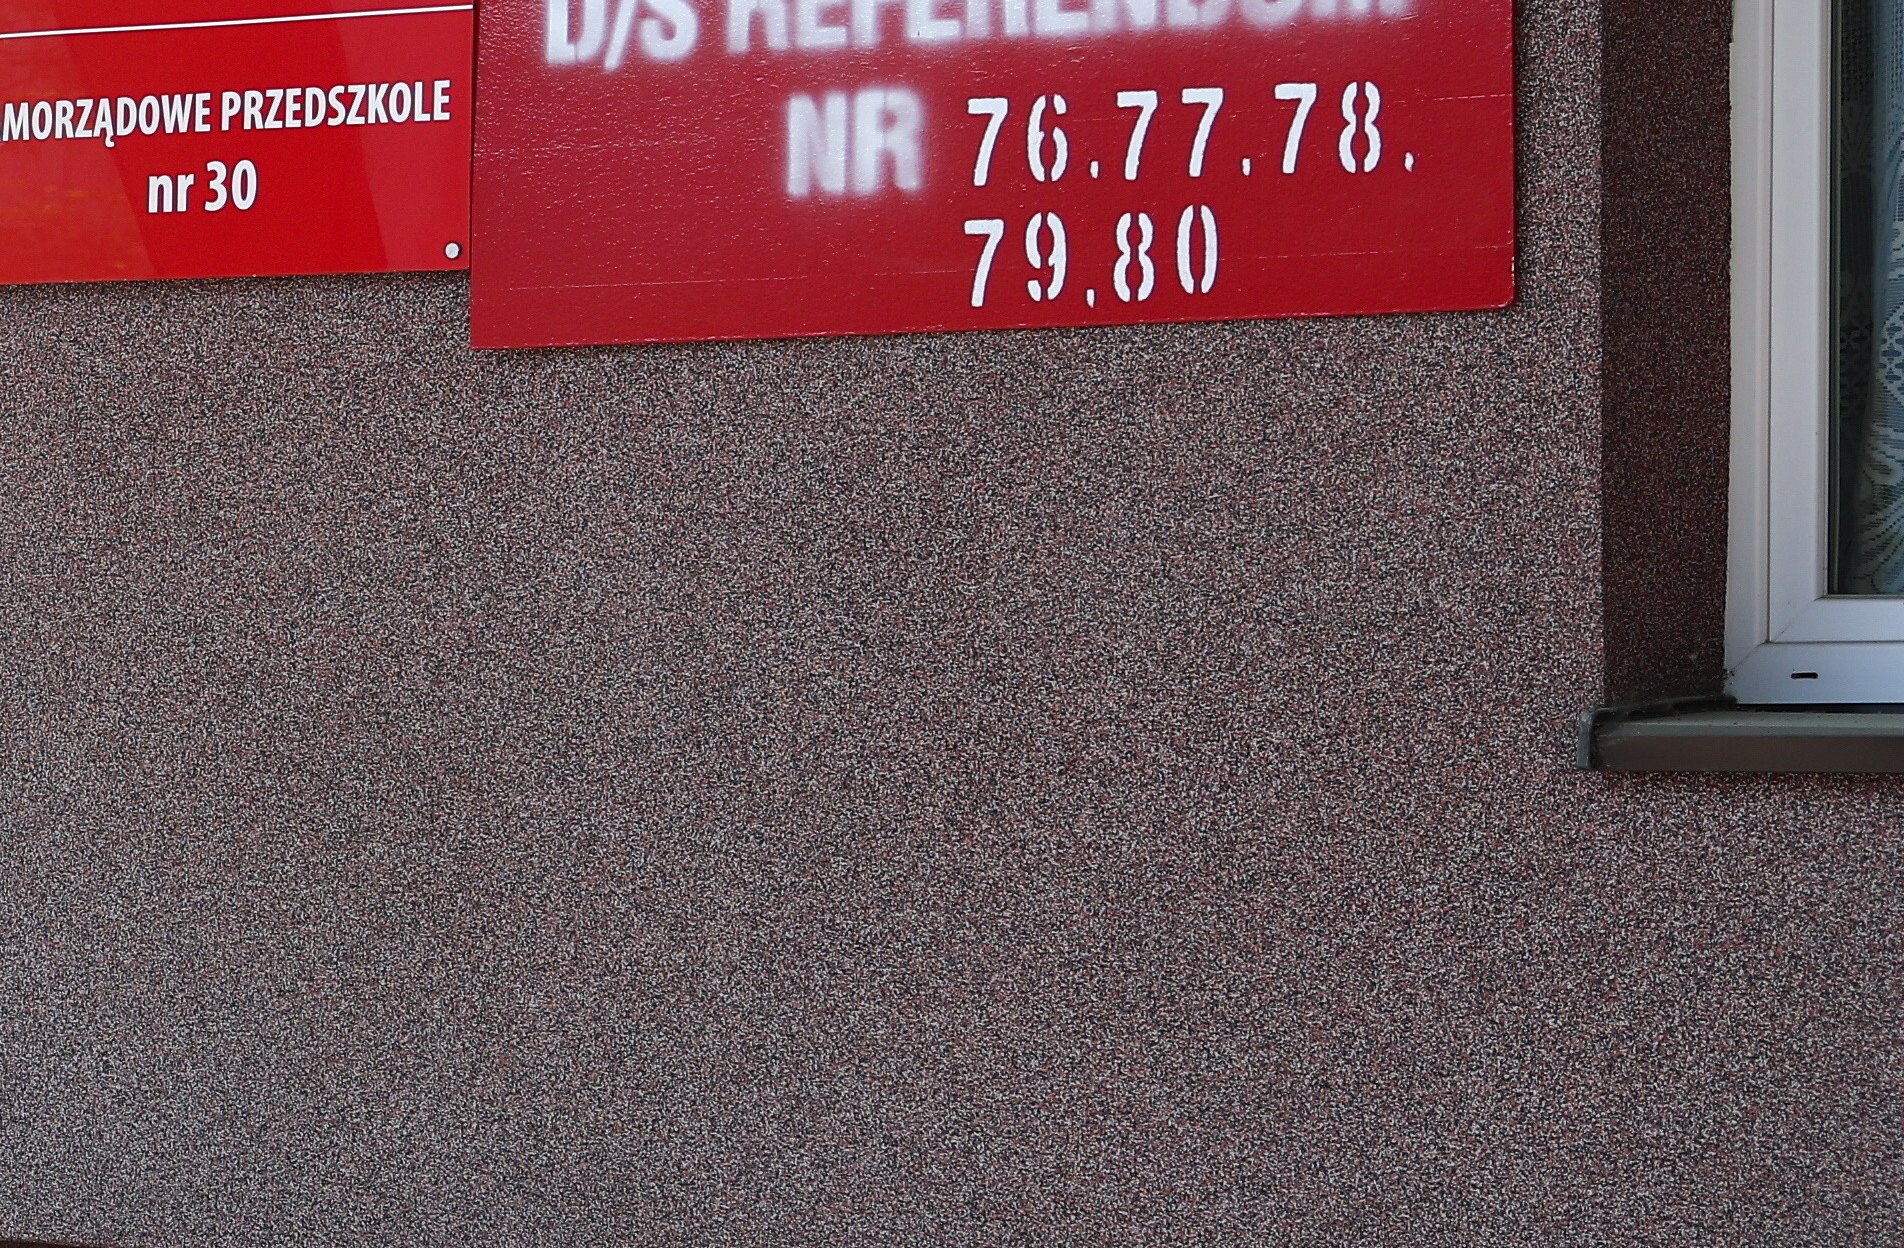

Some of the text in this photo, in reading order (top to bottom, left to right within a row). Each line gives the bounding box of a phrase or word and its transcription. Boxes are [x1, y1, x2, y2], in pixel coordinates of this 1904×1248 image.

[220, 79, 451, 132] PRZEDSZKOLE
[785, 84, 927, 202] NR
[147, 159, 258, 214] nr 30
